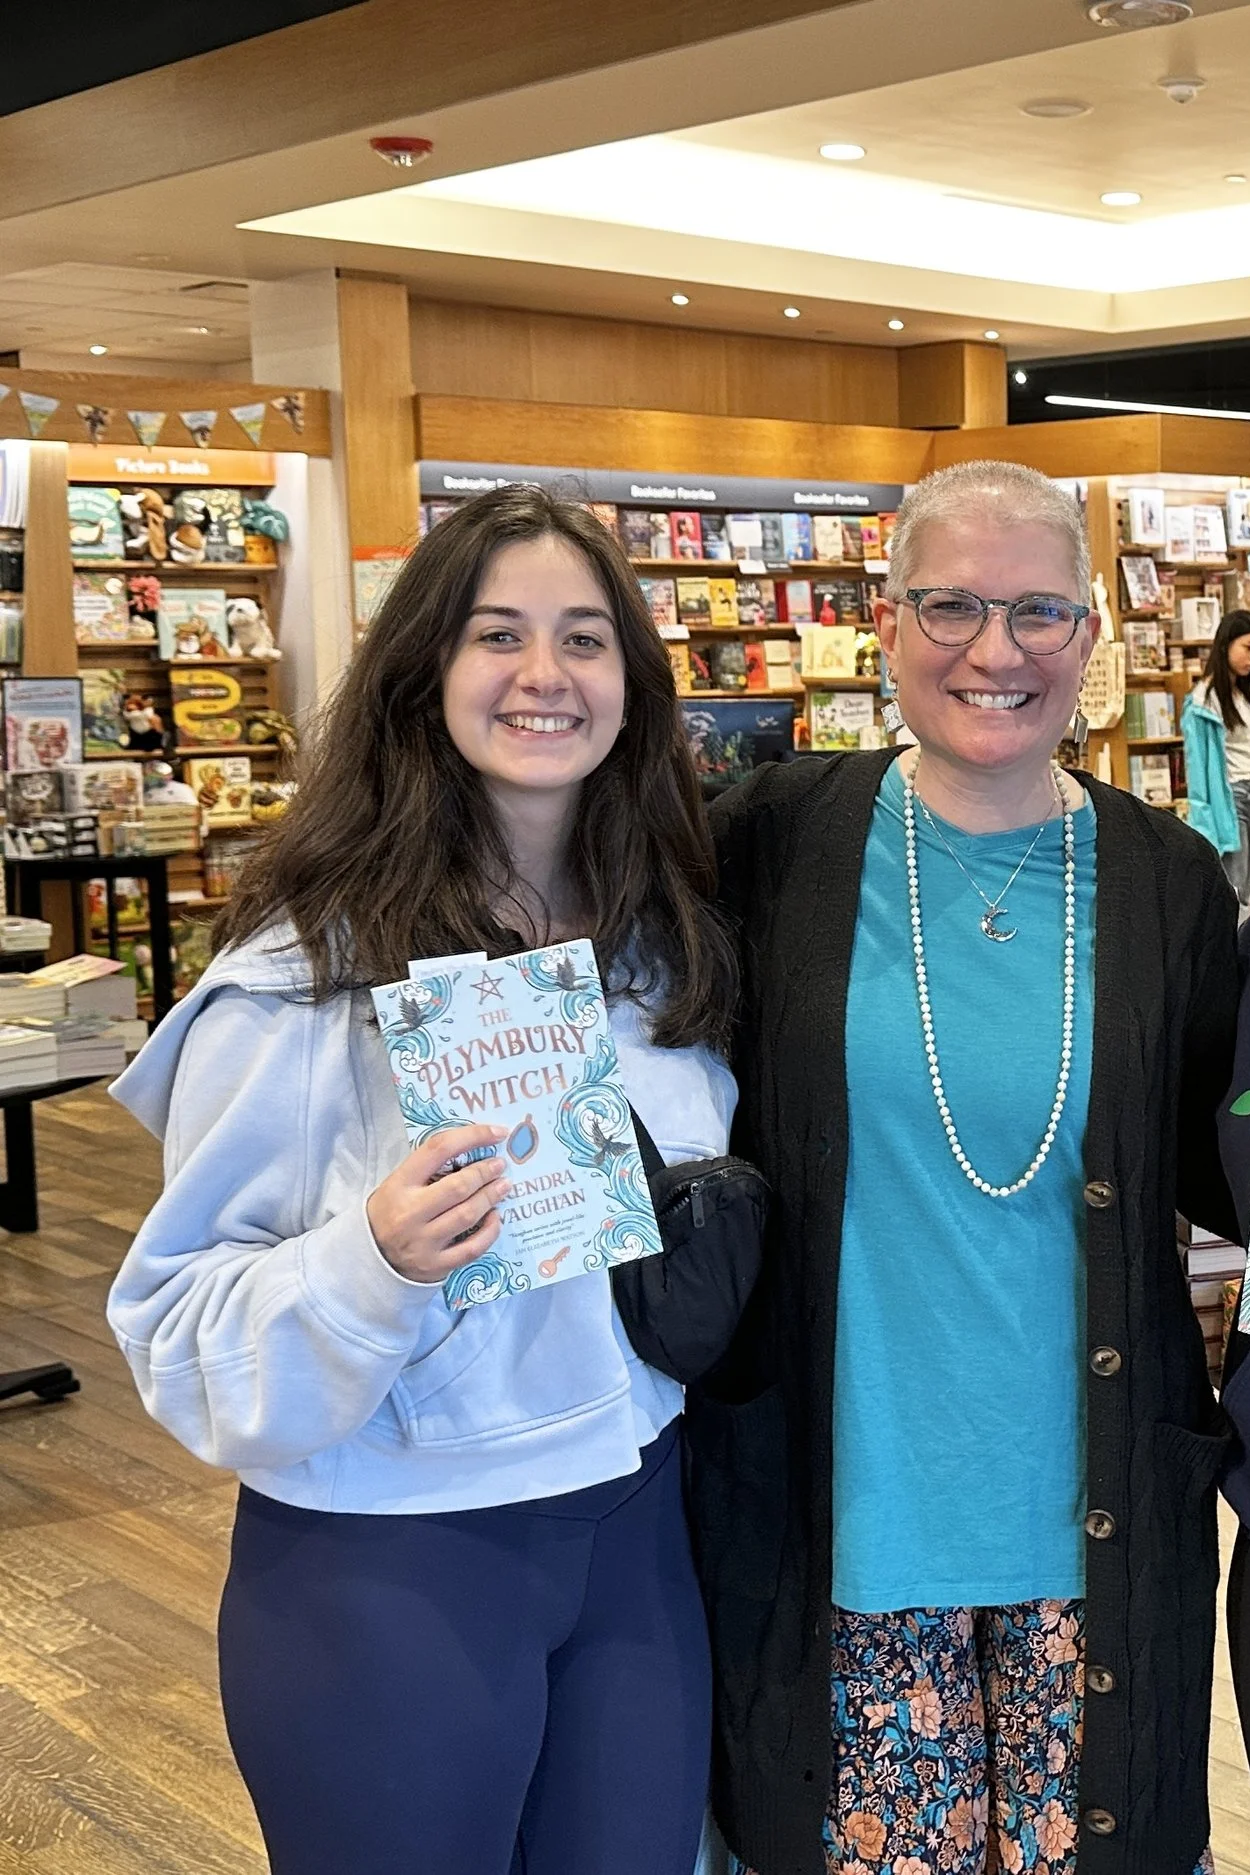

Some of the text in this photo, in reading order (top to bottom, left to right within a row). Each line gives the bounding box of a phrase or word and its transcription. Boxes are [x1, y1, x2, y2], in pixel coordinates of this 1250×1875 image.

[115, 457, 211, 476] Picture Books
[677, 486, 717, 501] Favorites
[835, 493, 870, 506] Favorites
[478, 1007, 513, 1027] THE
[417, 1024, 587, 1099] PLYMBURY
[449, 1062, 569, 1115] WITCH
[500, 1188, 587, 1225] VAUGHAN
